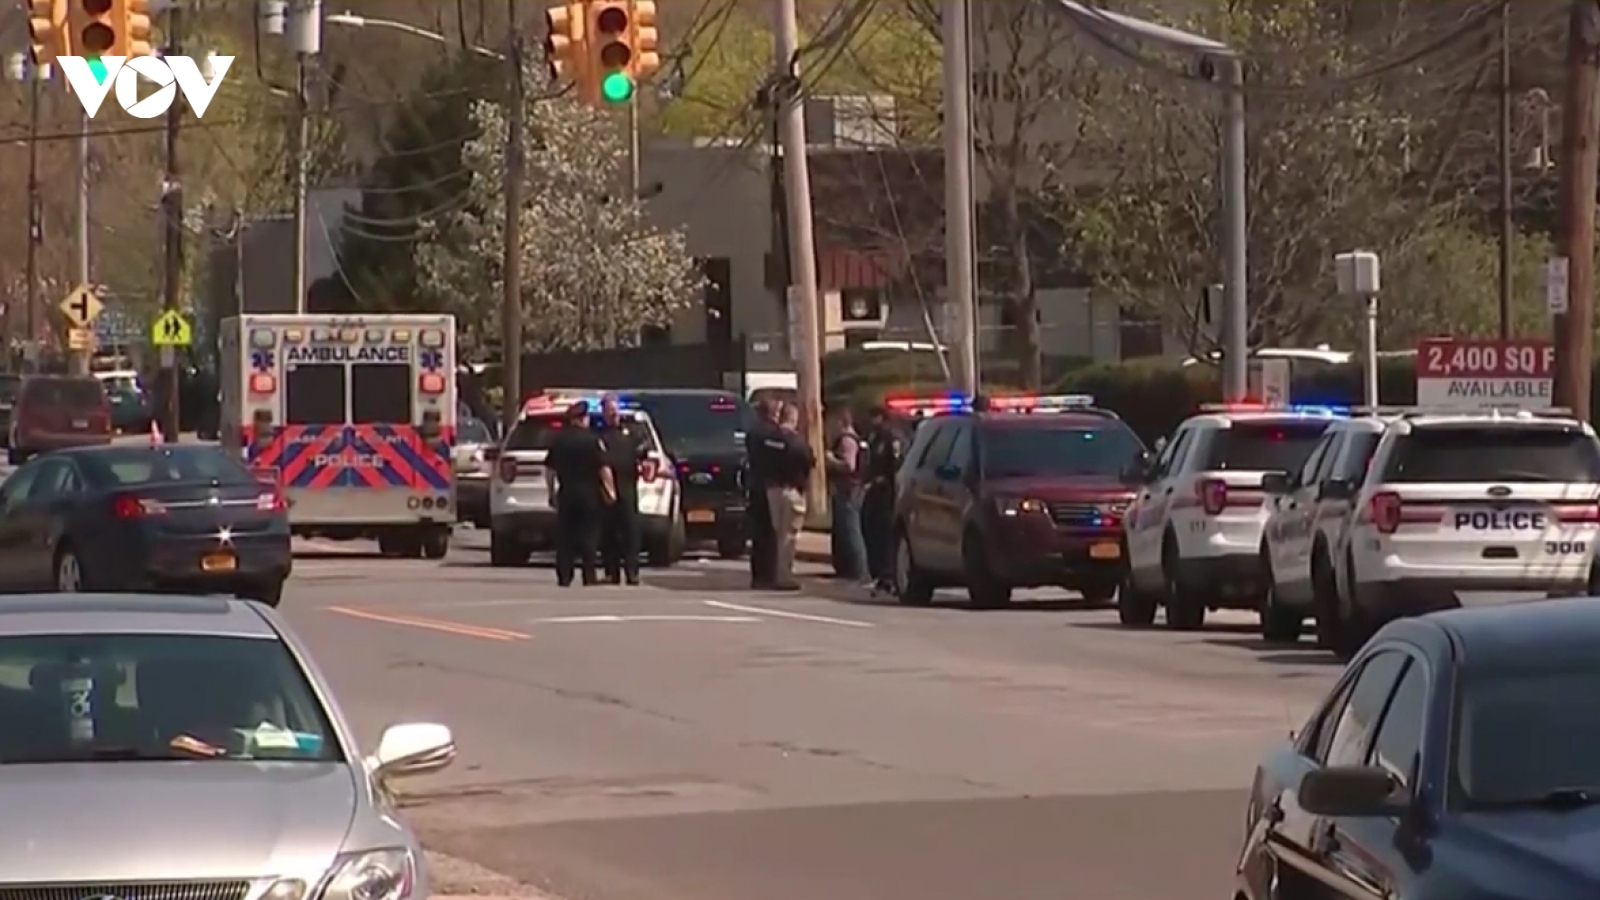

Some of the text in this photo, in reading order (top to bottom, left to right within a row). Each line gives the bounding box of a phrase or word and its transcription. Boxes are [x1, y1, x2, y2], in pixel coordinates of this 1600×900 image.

[287, 347, 409, 361] AMBULANCE
[1428, 347, 1497, 374] 2,400
[1505, 347, 1536, 374] SQ
[1448, 381, 1549, 397] AVAILABLE
[314, 453, 384, 467] POLICE
[1455, 512, 1545, 531] POLICE
